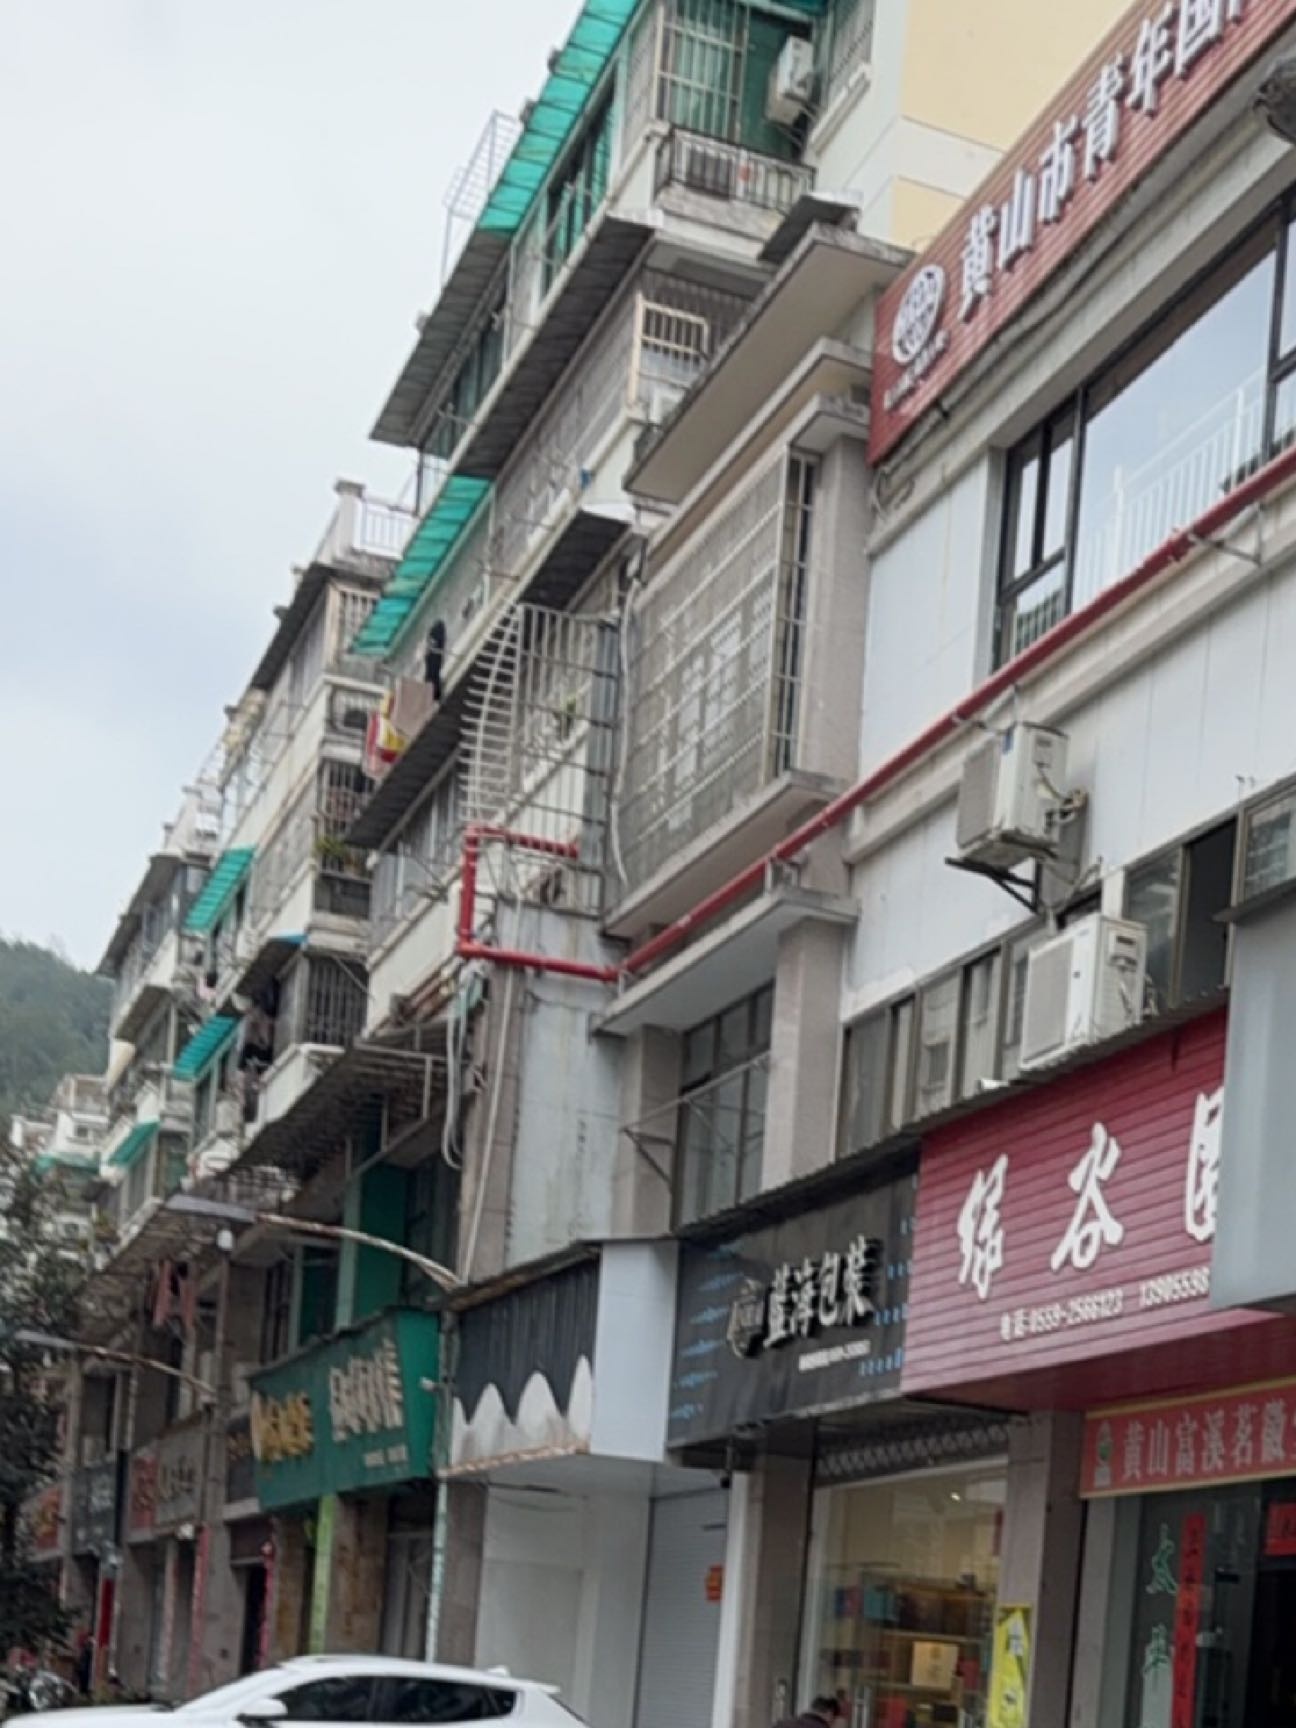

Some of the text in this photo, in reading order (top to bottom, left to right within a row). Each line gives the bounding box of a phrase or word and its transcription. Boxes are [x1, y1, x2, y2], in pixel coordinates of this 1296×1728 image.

[957, 0, 1242, 323] 黄山市青年国
